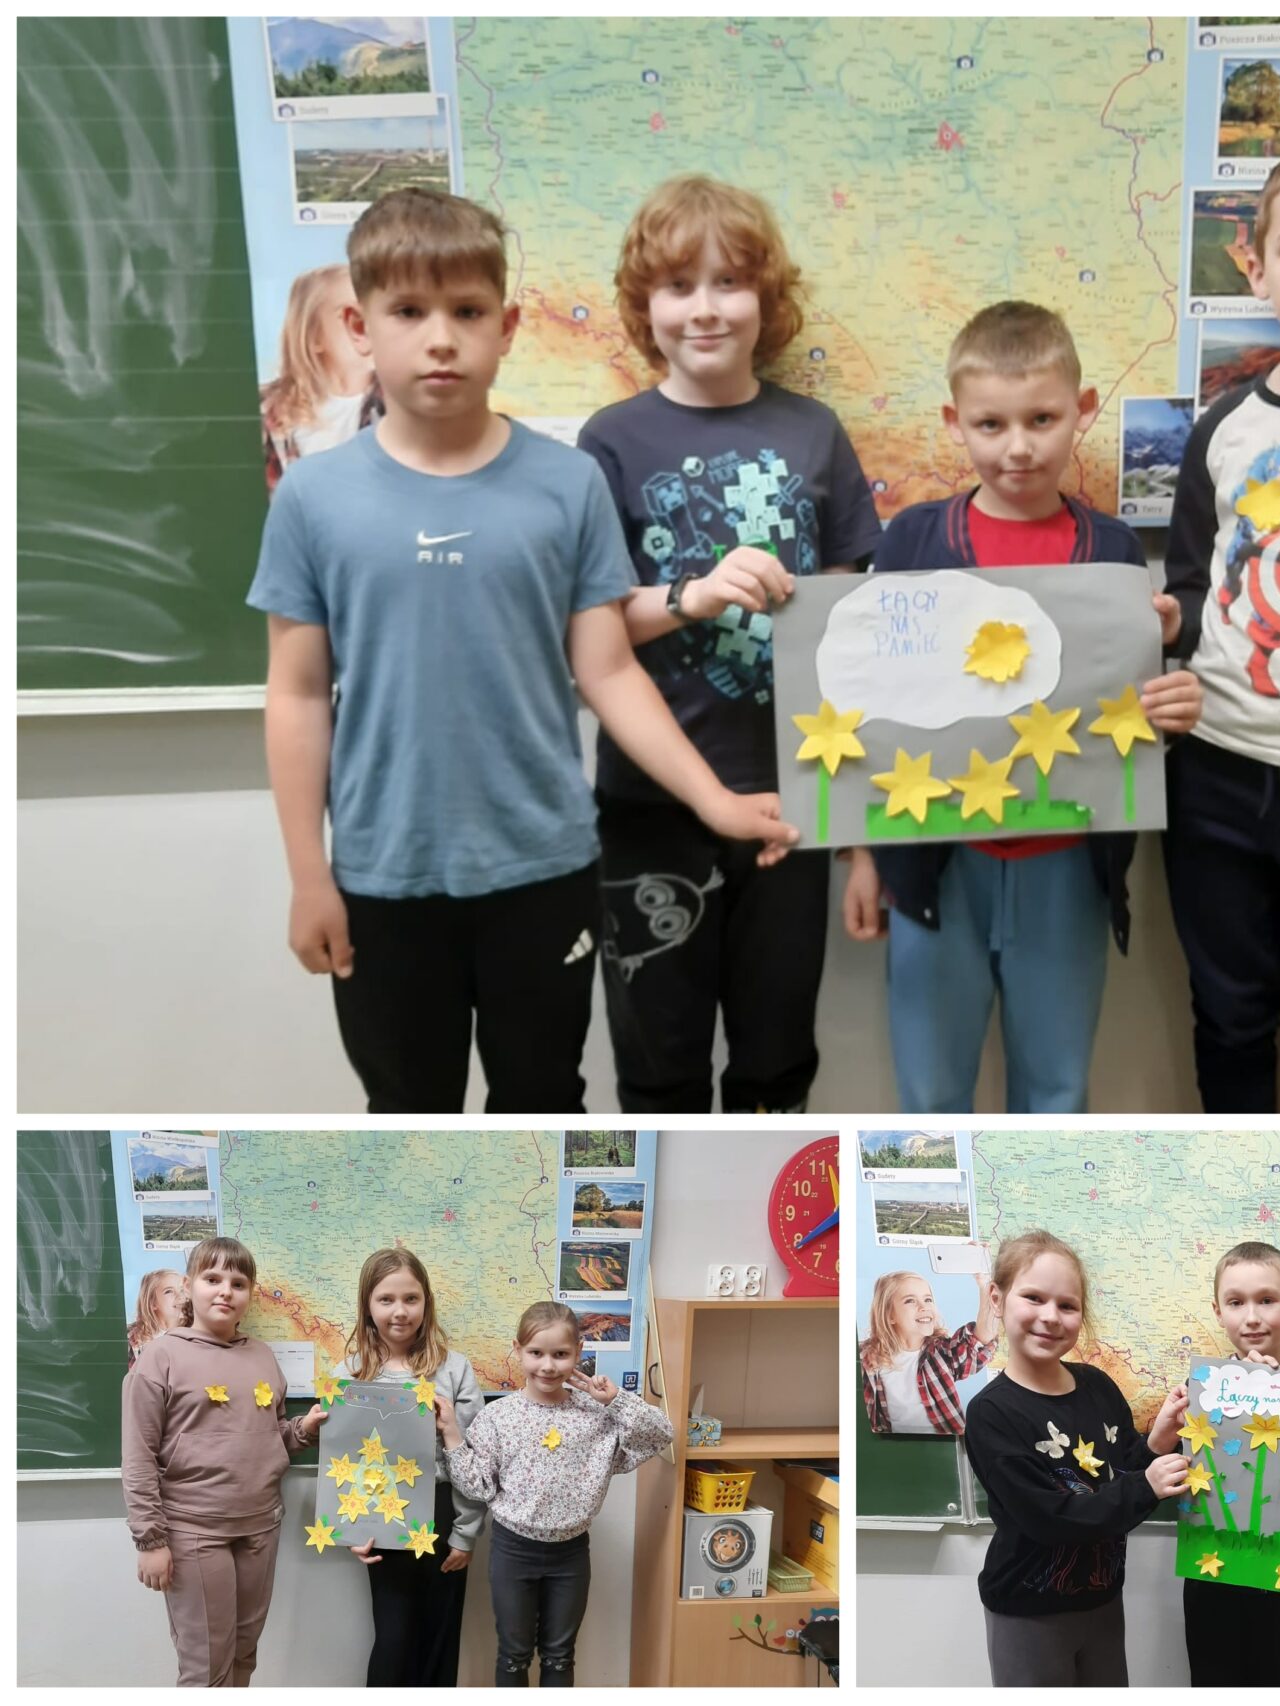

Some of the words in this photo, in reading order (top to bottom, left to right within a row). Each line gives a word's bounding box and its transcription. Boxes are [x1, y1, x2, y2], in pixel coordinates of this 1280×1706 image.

[417, 550, 464, 565] AIR
[808, 1159, 826, 1176] 11
[792, 1180, 811, 1197] 10
[785, 1204, 796, 1222] 9
[812, 1252, 822, 1268] 7
